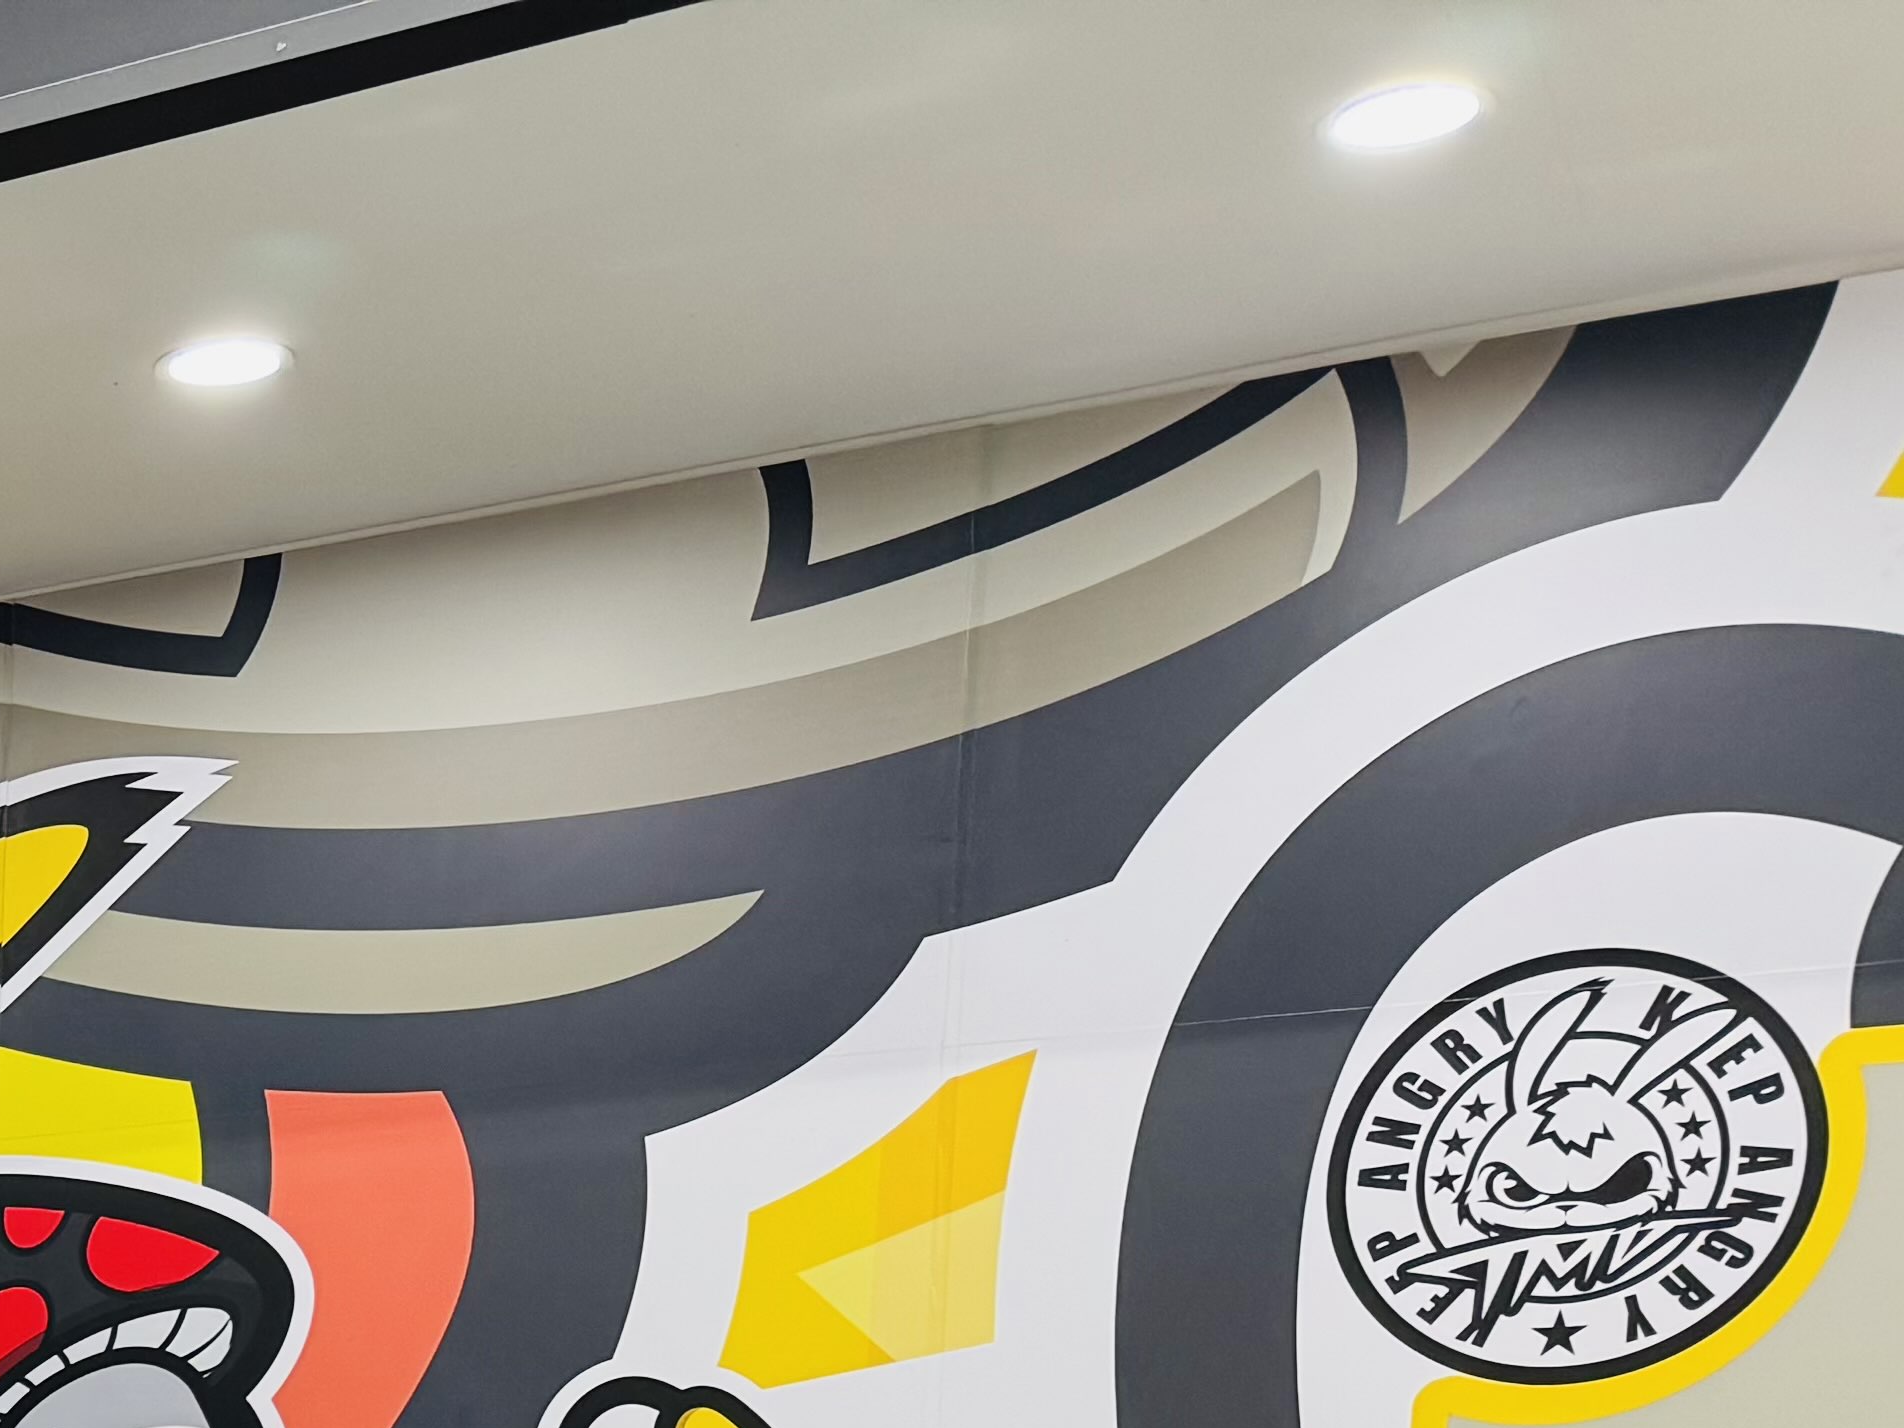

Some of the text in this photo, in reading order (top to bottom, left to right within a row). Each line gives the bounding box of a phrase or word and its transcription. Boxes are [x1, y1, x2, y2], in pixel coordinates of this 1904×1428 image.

[1358, 997, 1514, 1192] ANGRY
[1624, 984, 1794, 1343] KEP ANGRY
